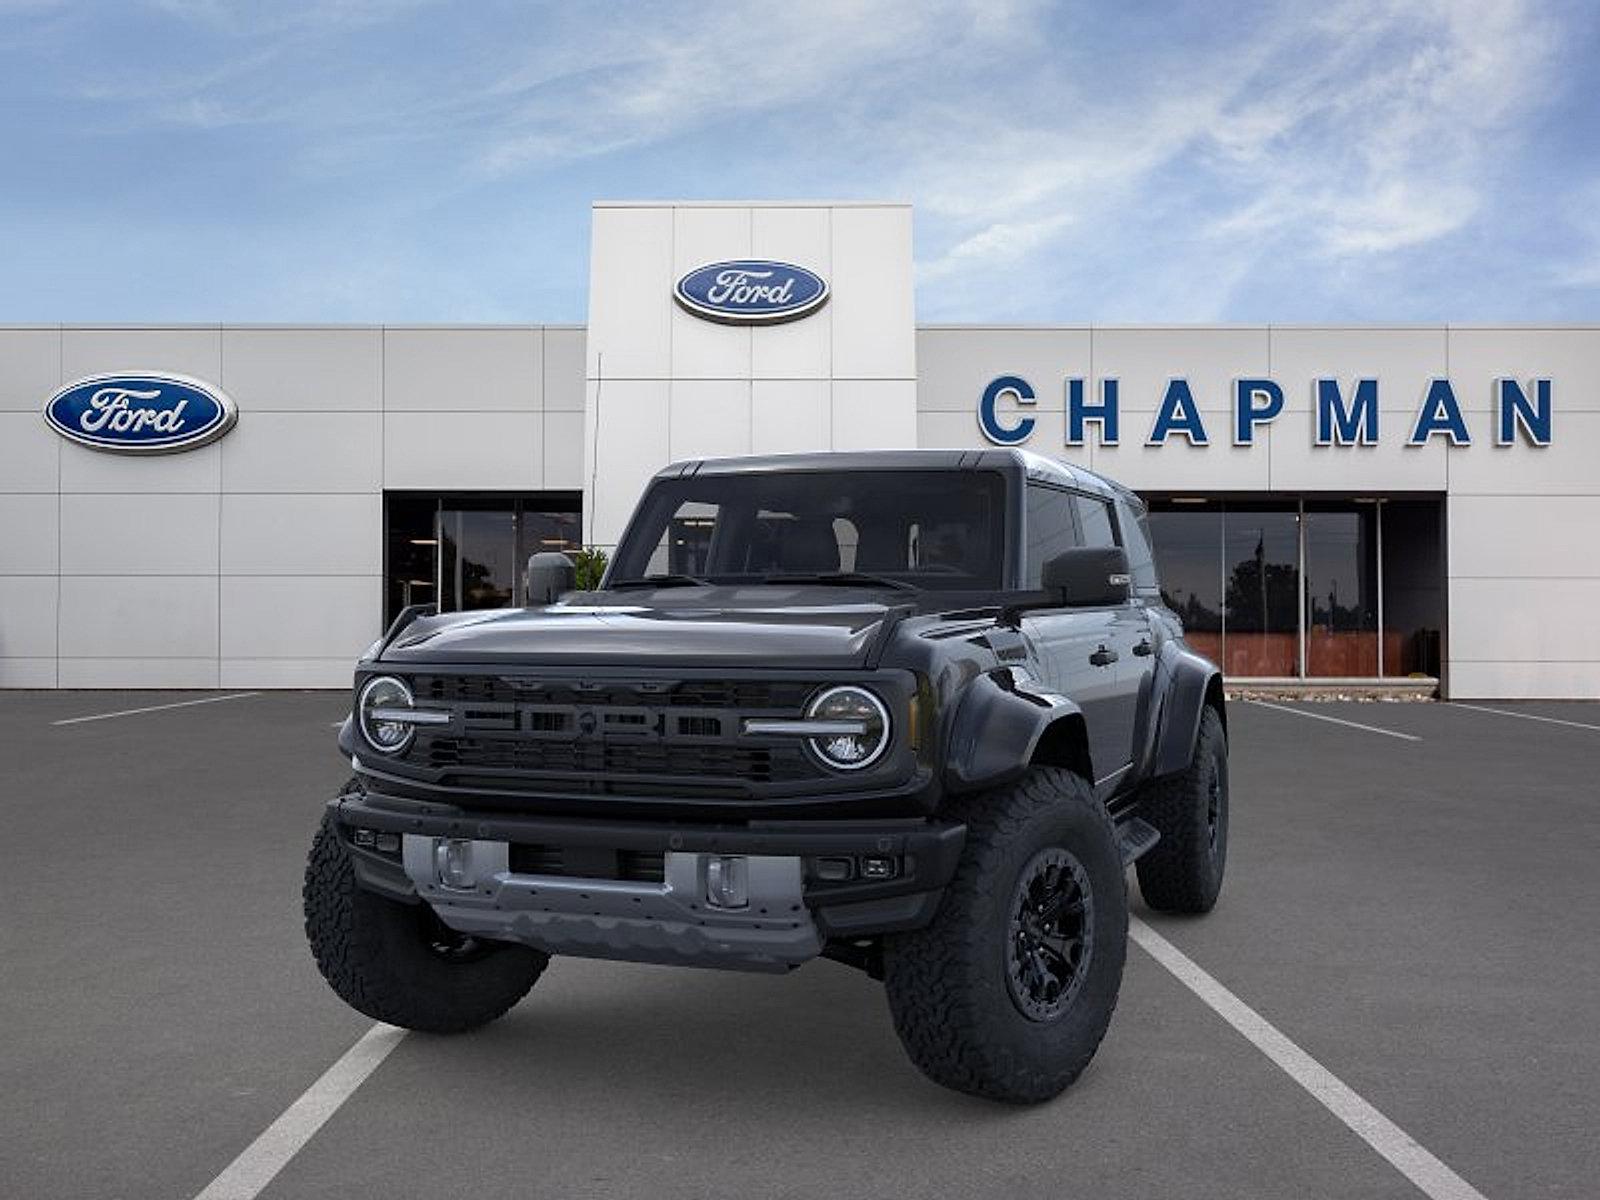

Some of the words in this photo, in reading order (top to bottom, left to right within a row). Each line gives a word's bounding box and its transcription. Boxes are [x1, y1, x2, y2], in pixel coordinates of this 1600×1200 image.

[707, 269, 795, 305] Ford
[79, 387, 190, 433] Ford
[977, 374, 1554, 447] CHAPMAN
